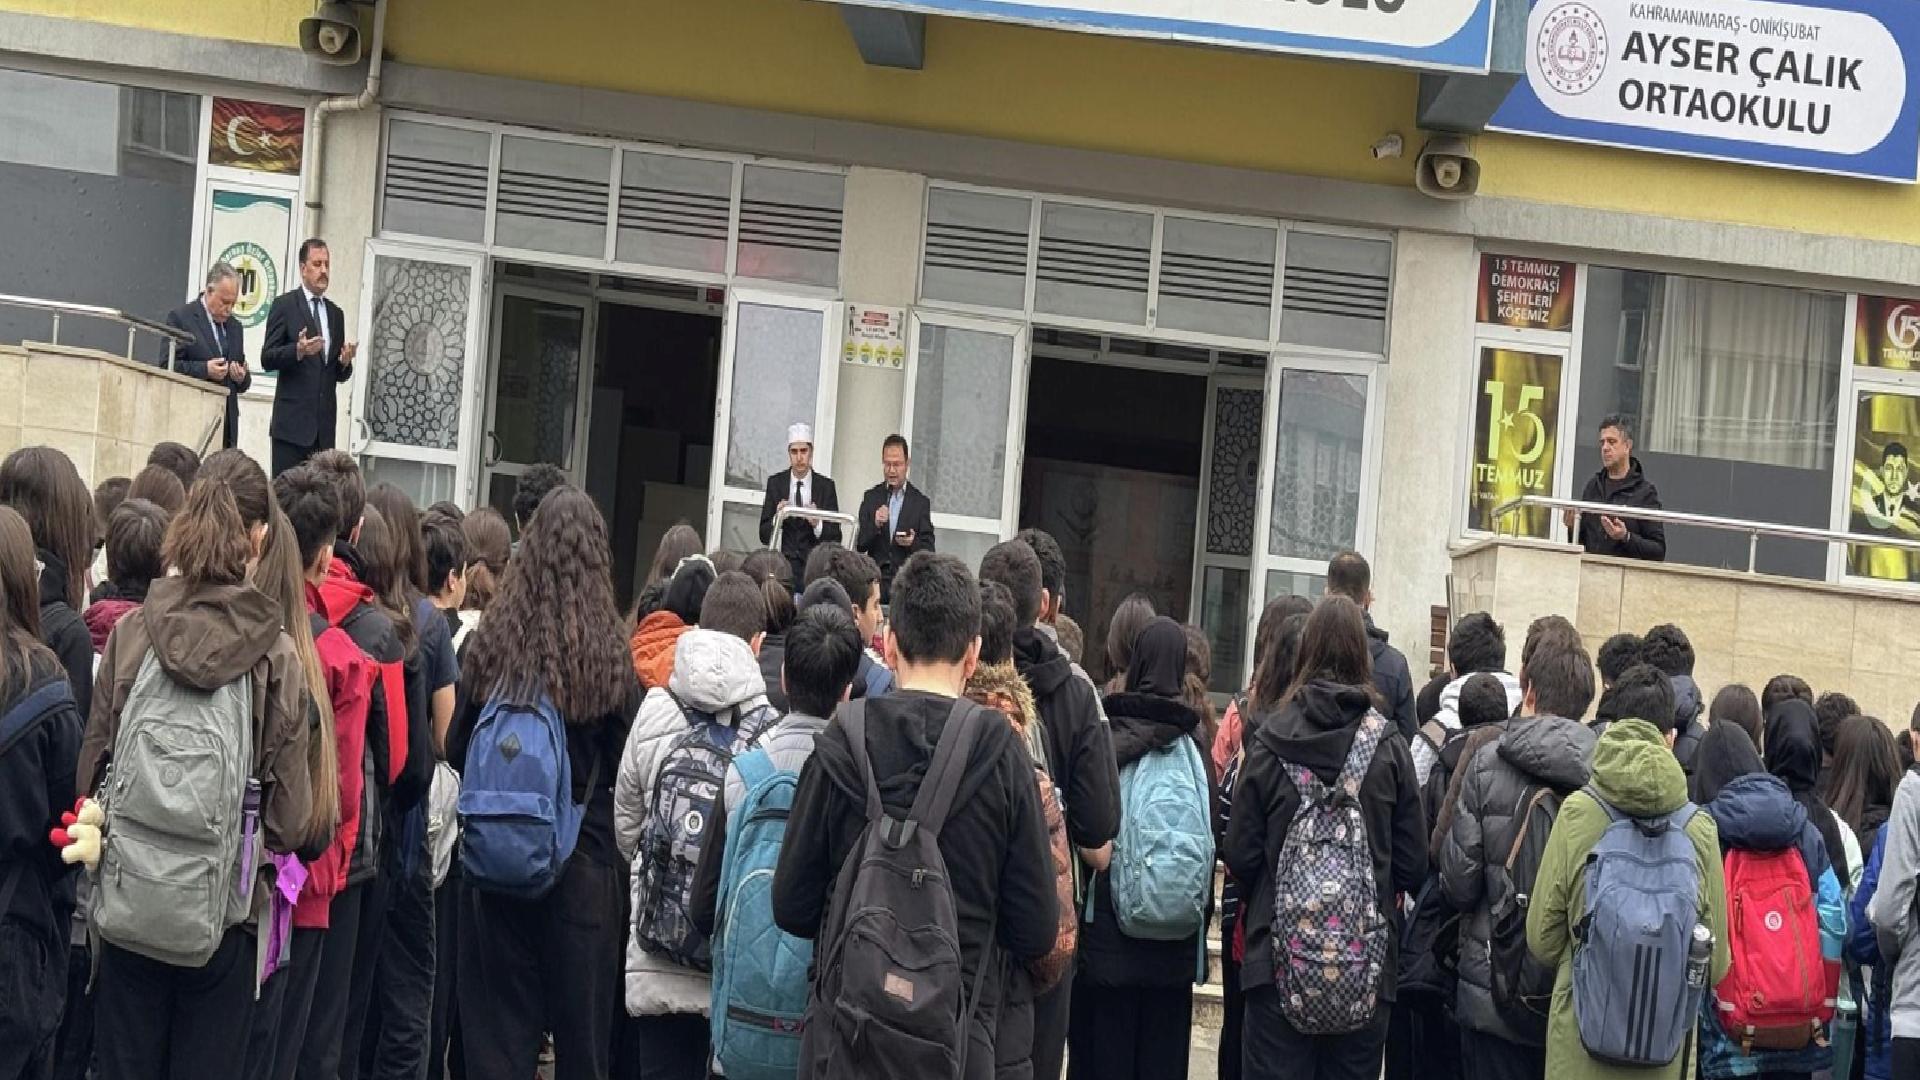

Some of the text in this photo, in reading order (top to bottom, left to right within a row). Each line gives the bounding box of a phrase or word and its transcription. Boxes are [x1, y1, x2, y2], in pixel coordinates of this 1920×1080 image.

[1629, 2, 1741, 35] KAHRAMANMARAŞ
[1750, 16, 1821, 40] ONİKİŞUBAT
[1621, 30, 1740, 75] AYSER
[1749, 46, 1863, 91] ÇALIK
[1618, 78, 1831, 135] ORTAOKULU
[1491, 273, 1560, 293] DEMOKRASİ
[1495, 259, 1561, 277] 15 TEMMUZ
[1485, 380, 1545, 464] 15
